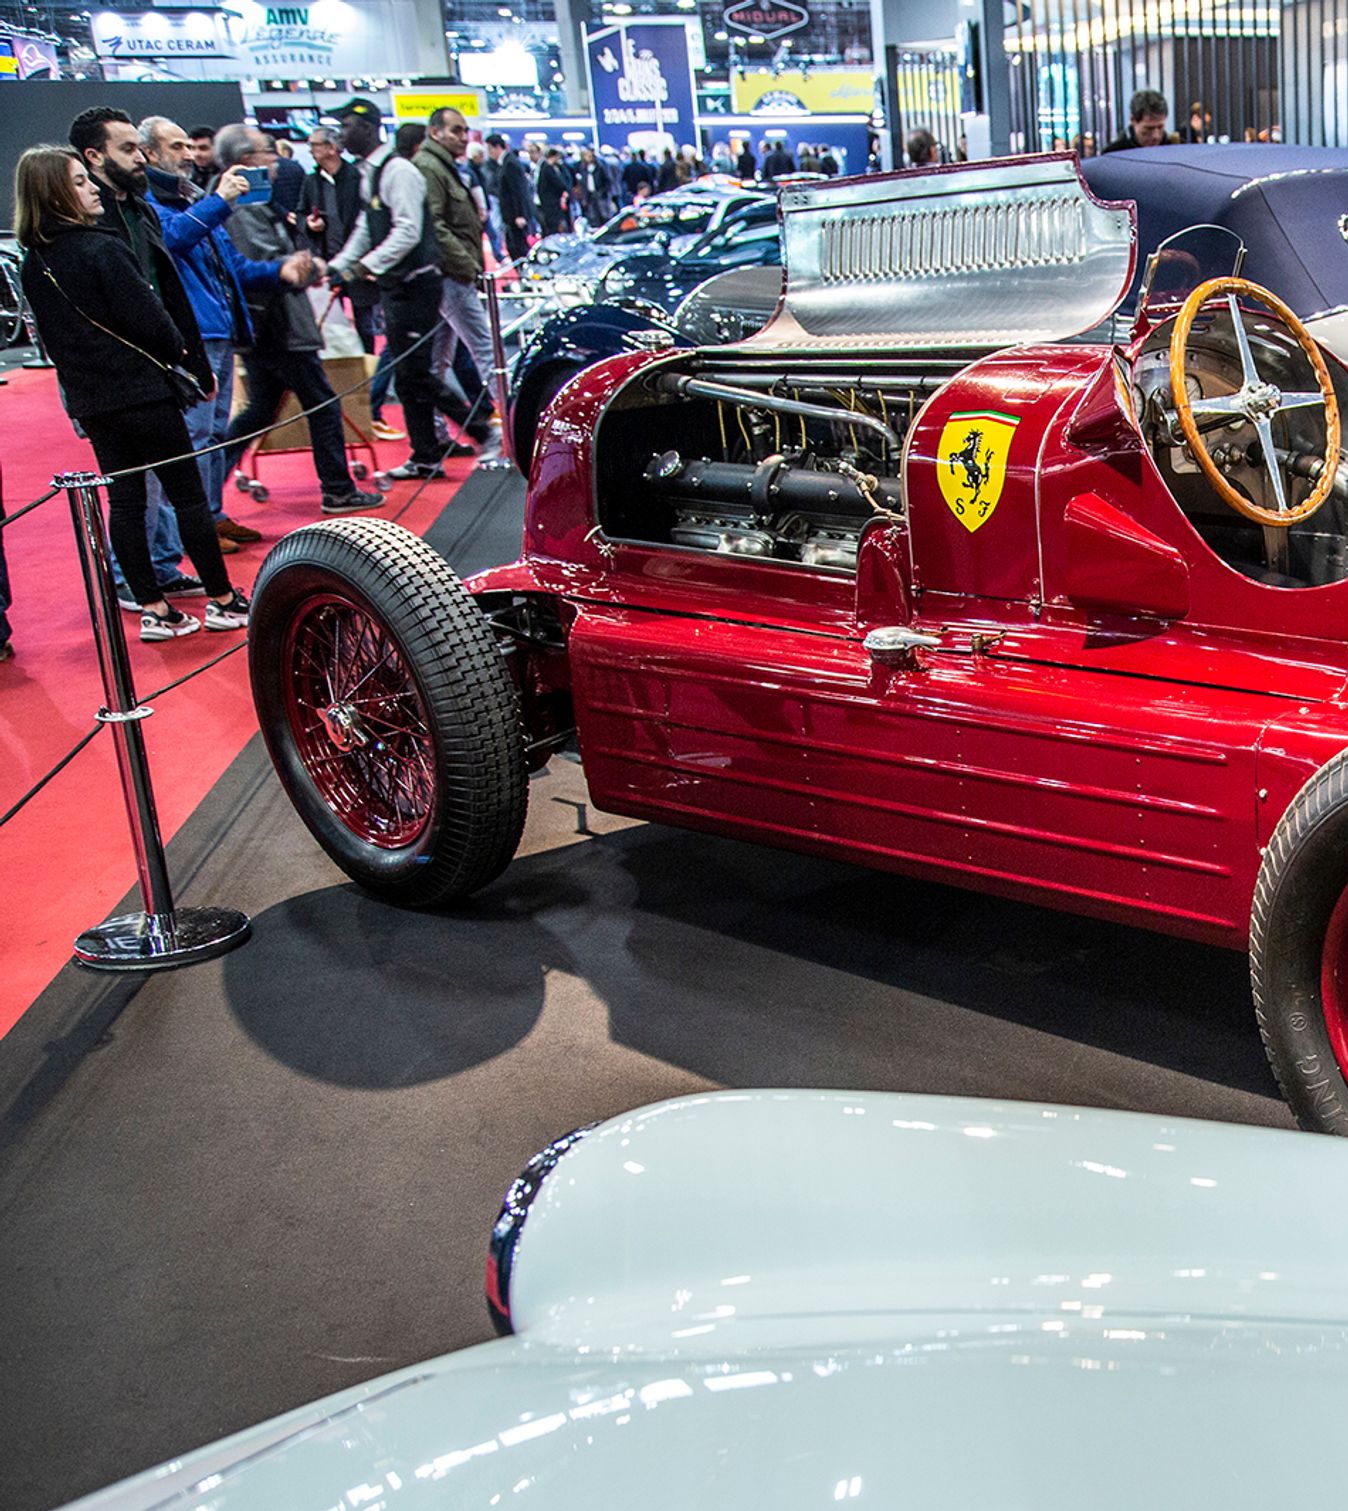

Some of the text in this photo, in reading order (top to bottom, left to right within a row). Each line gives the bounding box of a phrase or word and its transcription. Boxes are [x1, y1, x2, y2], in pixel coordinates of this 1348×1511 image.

[266, 7, 308, 26] AMV
[127, 38, 216, 51] UTAC CERAM
[956, 498, 965, 515] S
